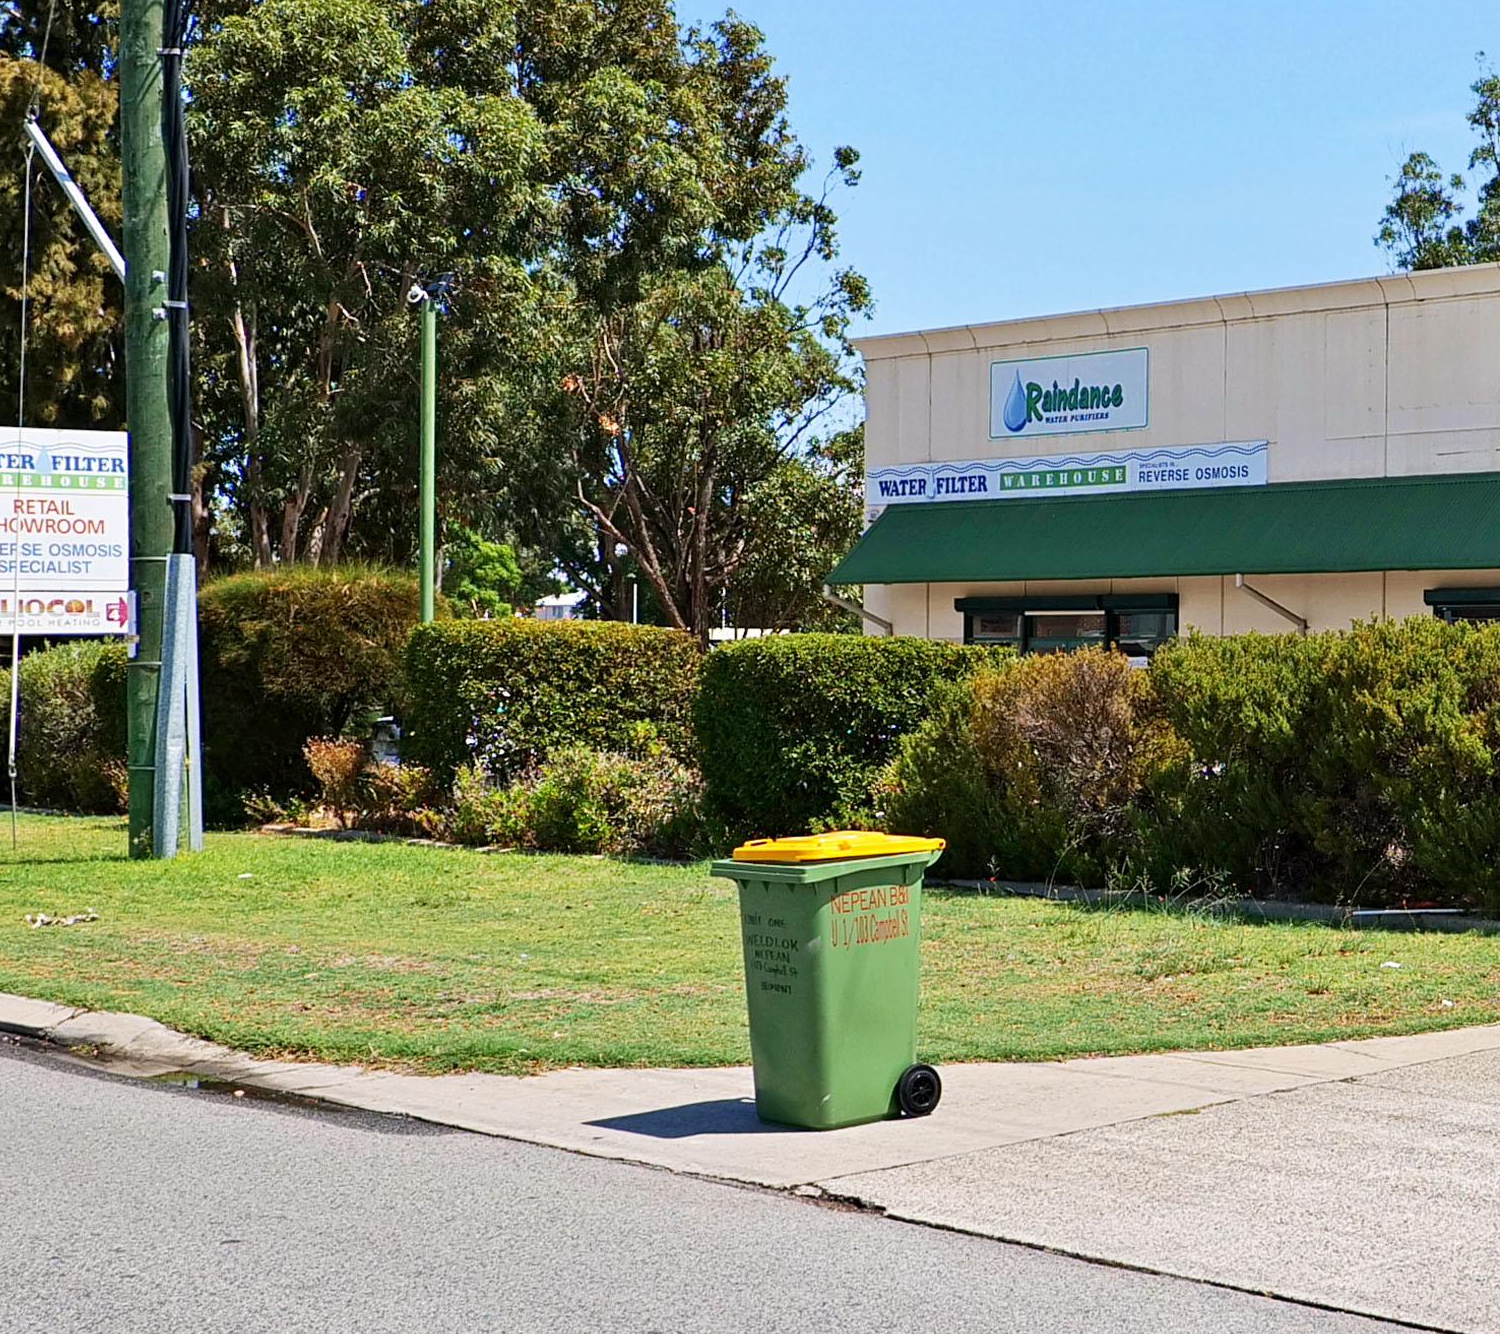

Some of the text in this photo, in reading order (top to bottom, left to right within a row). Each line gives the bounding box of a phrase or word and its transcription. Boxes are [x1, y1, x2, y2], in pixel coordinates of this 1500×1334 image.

[1026, 378, 1124, 422] Raindance
[1046, 412, 1109, 424] WATER PURIFIERS
[52, 455, 126, 473] FILTER
[1003, 468, 1124, 488] WAREHOUSE
[1138, 465, 1250, 483] REVERSE OSMOSIS
[879, 475, 988, 496] WATER FILTER
[13, 499, 75, 516] RETAIL
[49, 543, 122, 557] OSMOSIS
[50, 619, 100, 627] HEATING
[830, 888, 888, 914] NEPEAN
[746, 934, 799, 952] WELDLOK
